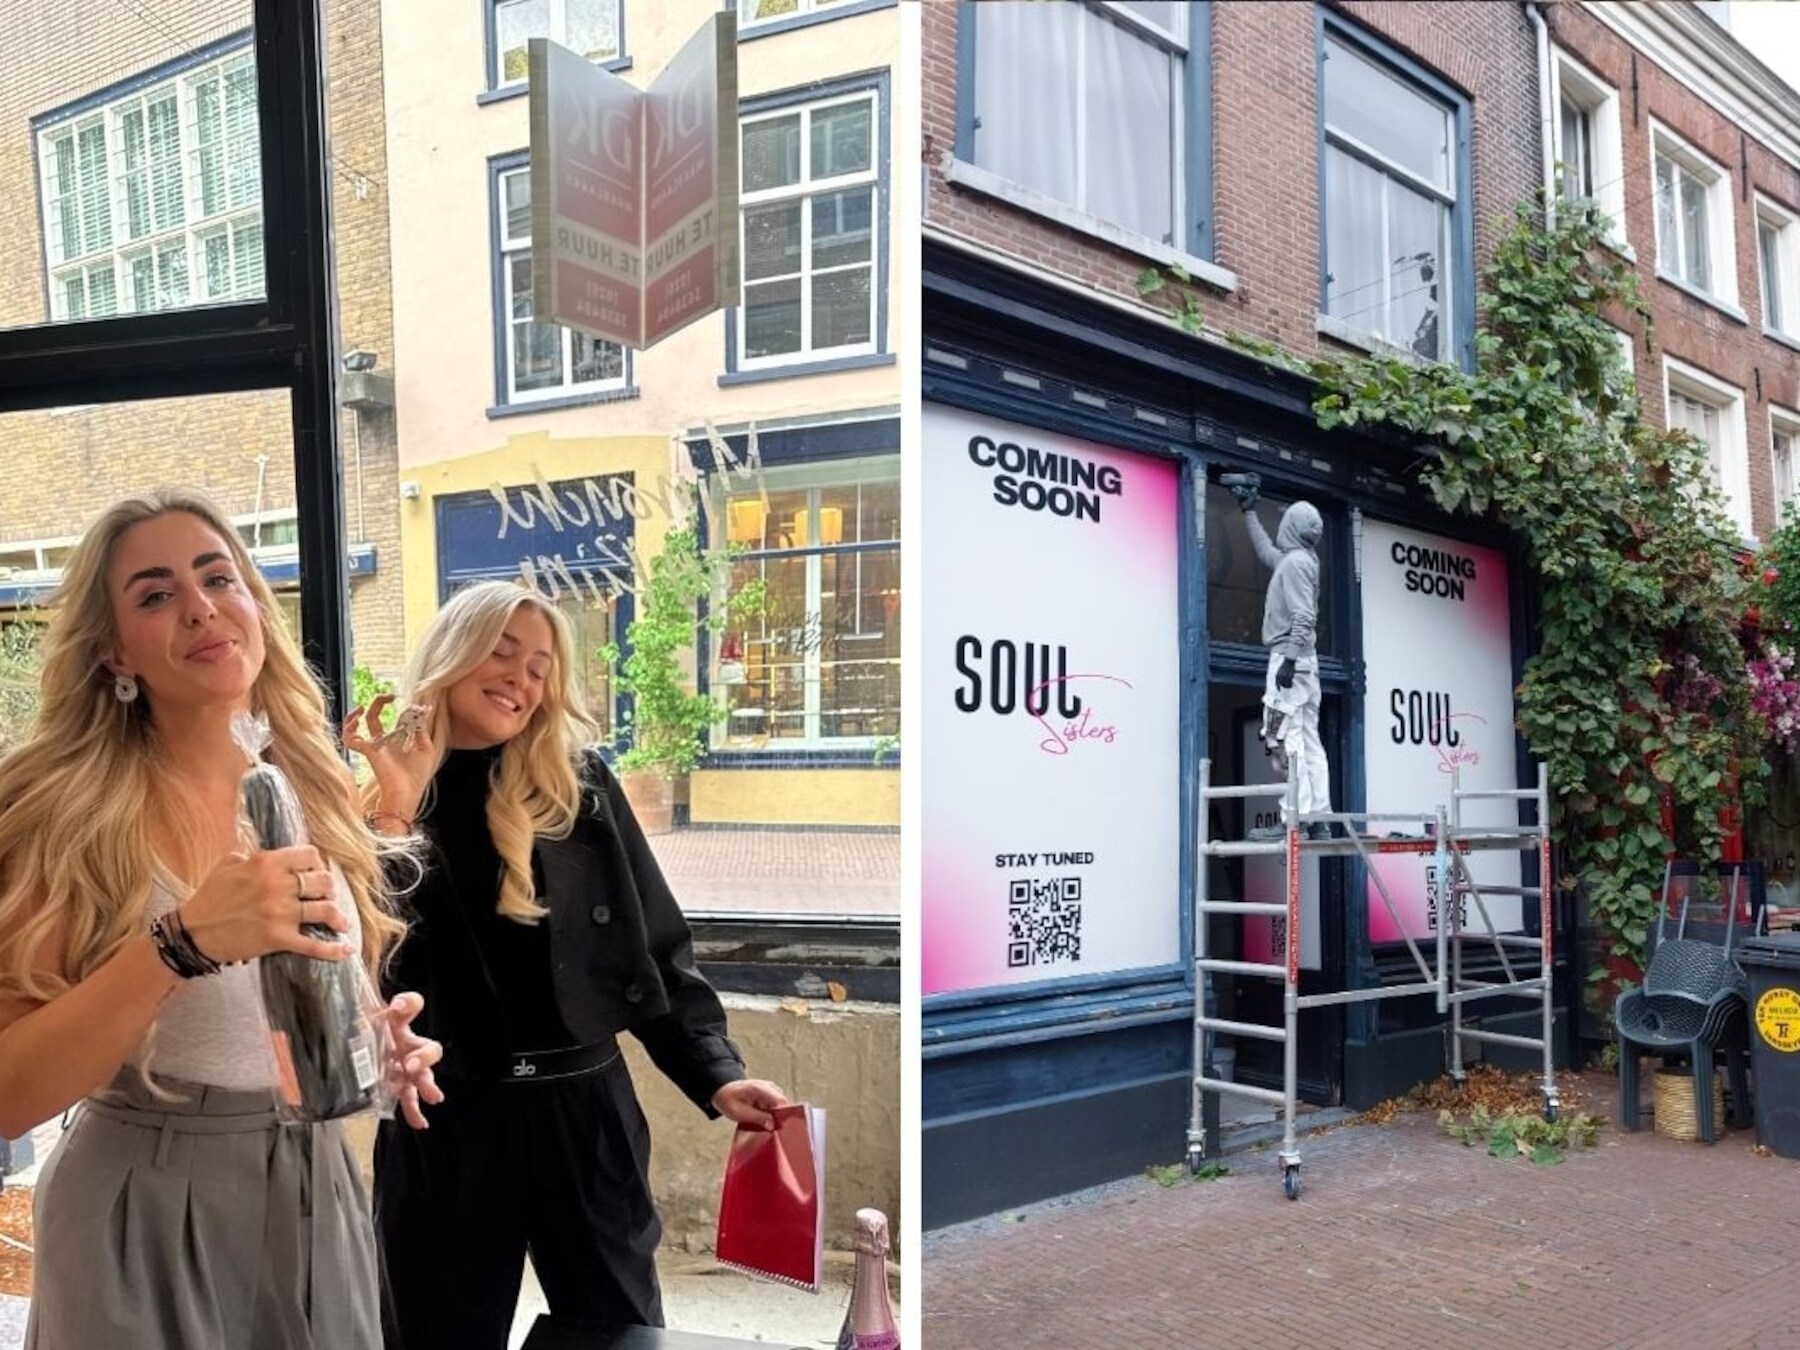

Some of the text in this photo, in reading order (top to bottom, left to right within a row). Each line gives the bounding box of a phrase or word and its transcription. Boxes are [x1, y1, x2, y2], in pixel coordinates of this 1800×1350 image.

[968, 435, 1122, 496] COMING
[993, 475, 1100, 523] SOON
[1391, 542, 1477, 580] COMING
[1405, 570, 1465, 601] SOON
[954, 634, 1081, 719] SOUL
[1026, 674, 1133, 755] Sisters
[1391, 688, 1460, 747] SOUL
[995, 852, 1095, 868] STAY TUNED
